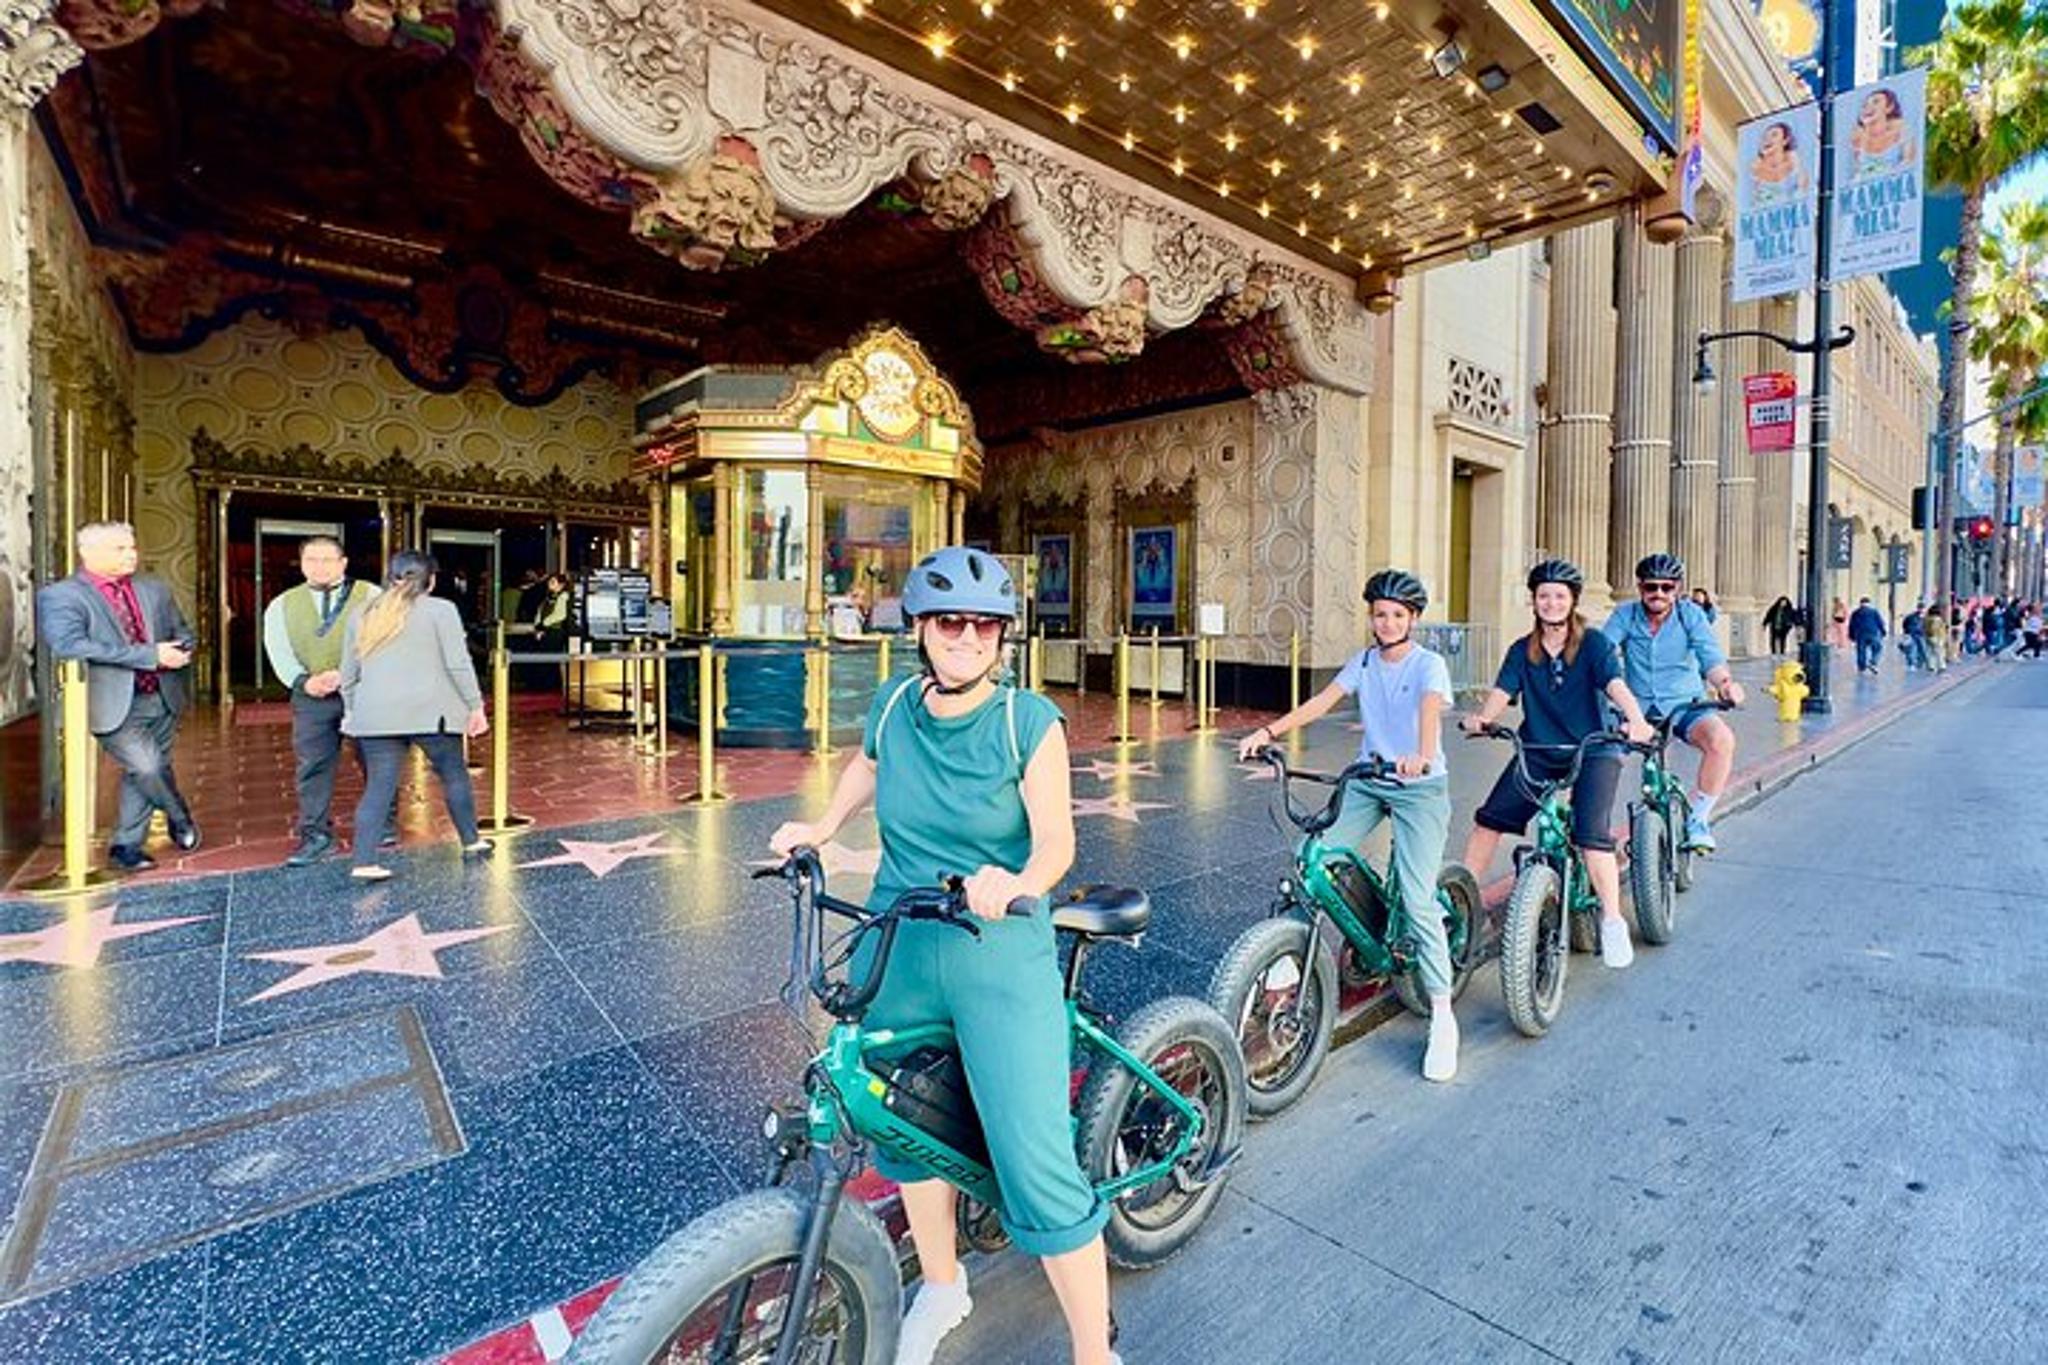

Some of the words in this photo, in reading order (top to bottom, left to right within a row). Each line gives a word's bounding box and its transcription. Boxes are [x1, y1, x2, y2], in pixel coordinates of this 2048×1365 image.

[1839, 174, 1916, 213] MAMMA
[1740, 204, 1810, 240] MAMMA
[1854, 205, 1899, 236] MIA!
[1755, 232, 1795, 259] MIA!
